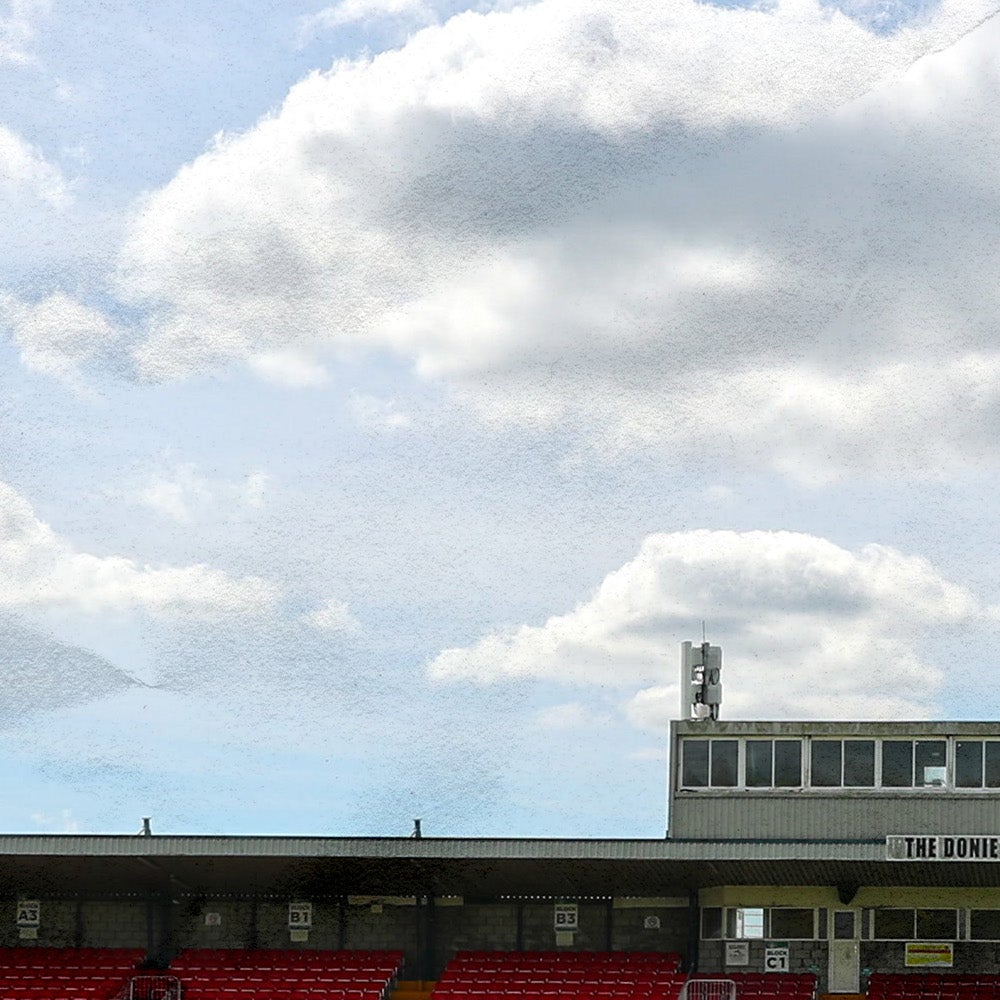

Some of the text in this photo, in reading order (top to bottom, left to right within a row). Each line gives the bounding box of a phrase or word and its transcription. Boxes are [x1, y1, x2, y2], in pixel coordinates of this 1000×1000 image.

[905, 838, 937, 858] THE
[944, 838, 998, 858] DONIE
[18, 909, 38, 921] A3
[290, 911, 309, 923] B1
[556, 913, 576, 924] B3
[767, 957, 786, 969] C1
